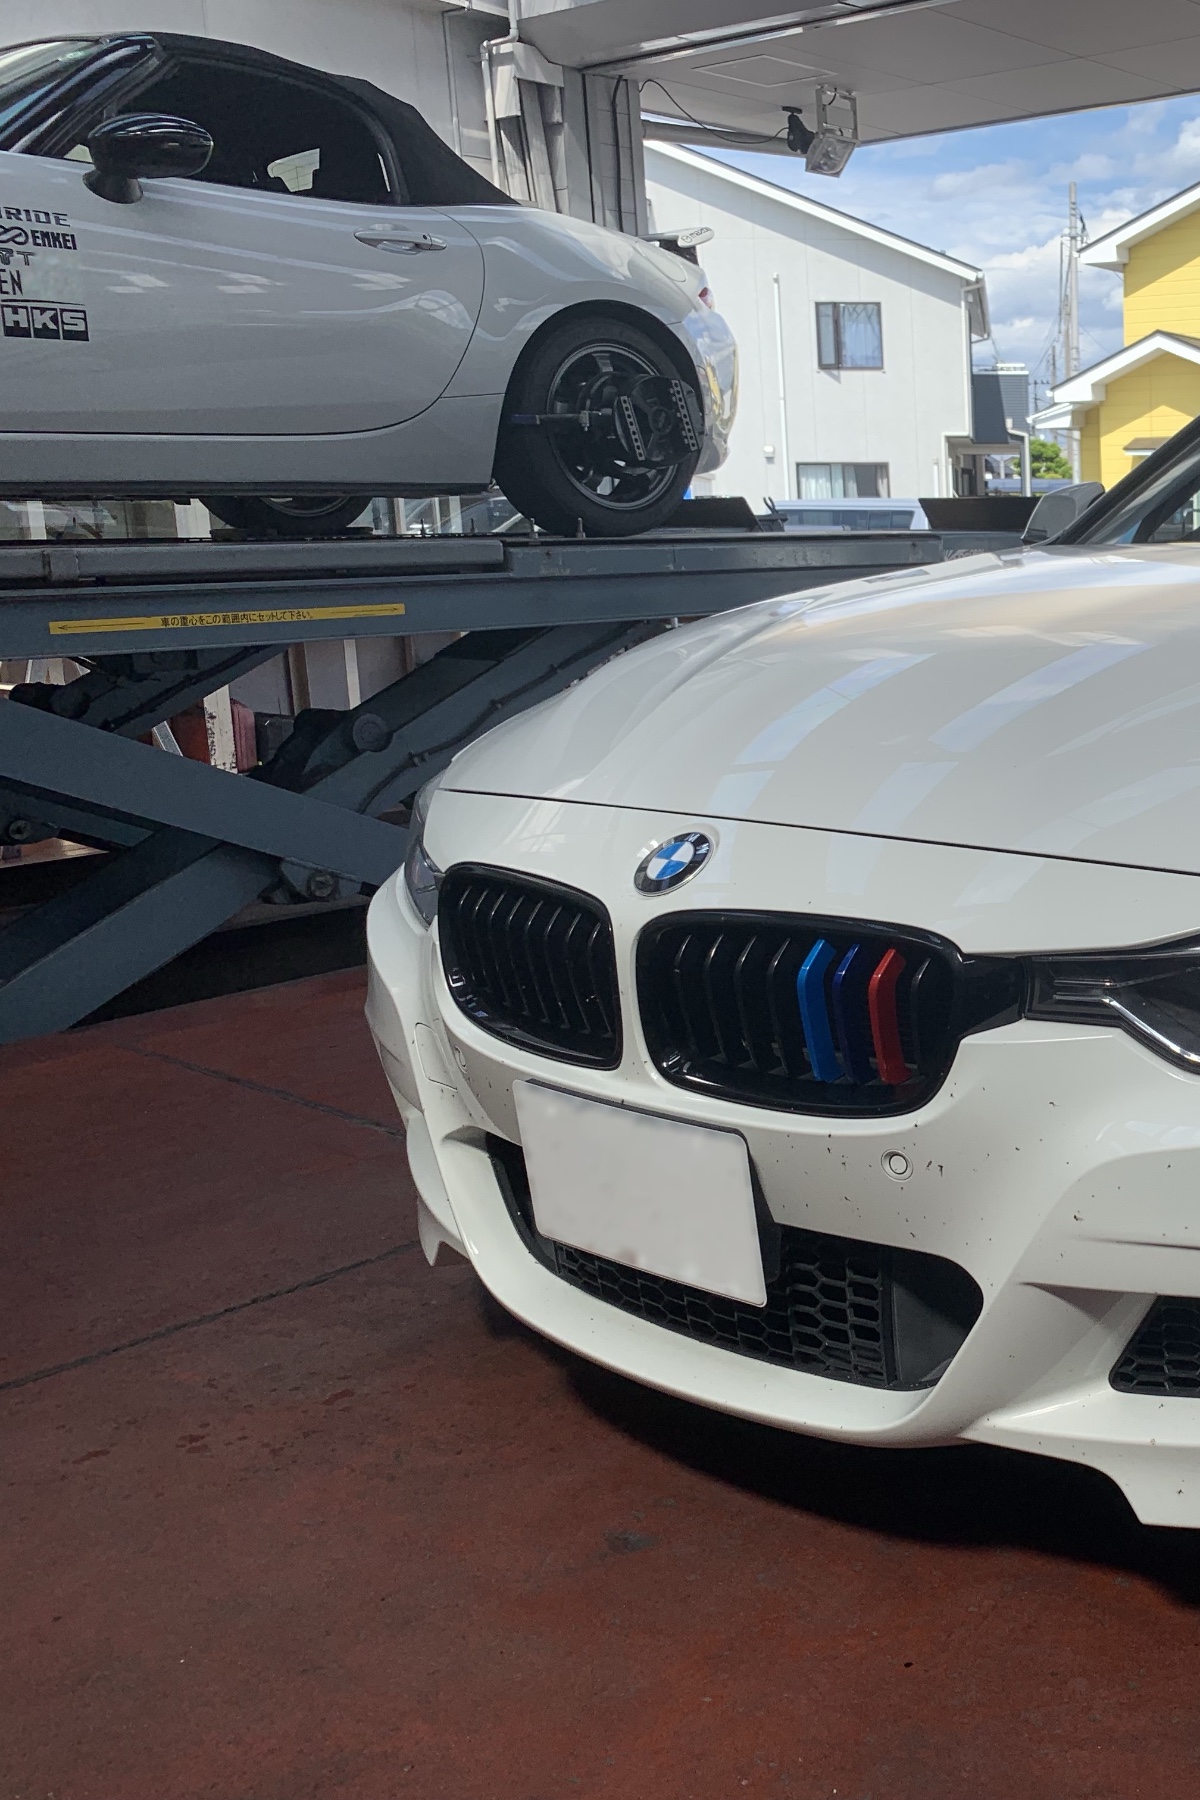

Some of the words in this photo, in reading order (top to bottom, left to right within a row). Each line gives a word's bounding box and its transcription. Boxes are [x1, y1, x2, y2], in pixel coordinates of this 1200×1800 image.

[0, 206, 71, 227] RIDE
[31, 229, 77, 249] ENKEI
[2, 306, 88, 334] HKS
